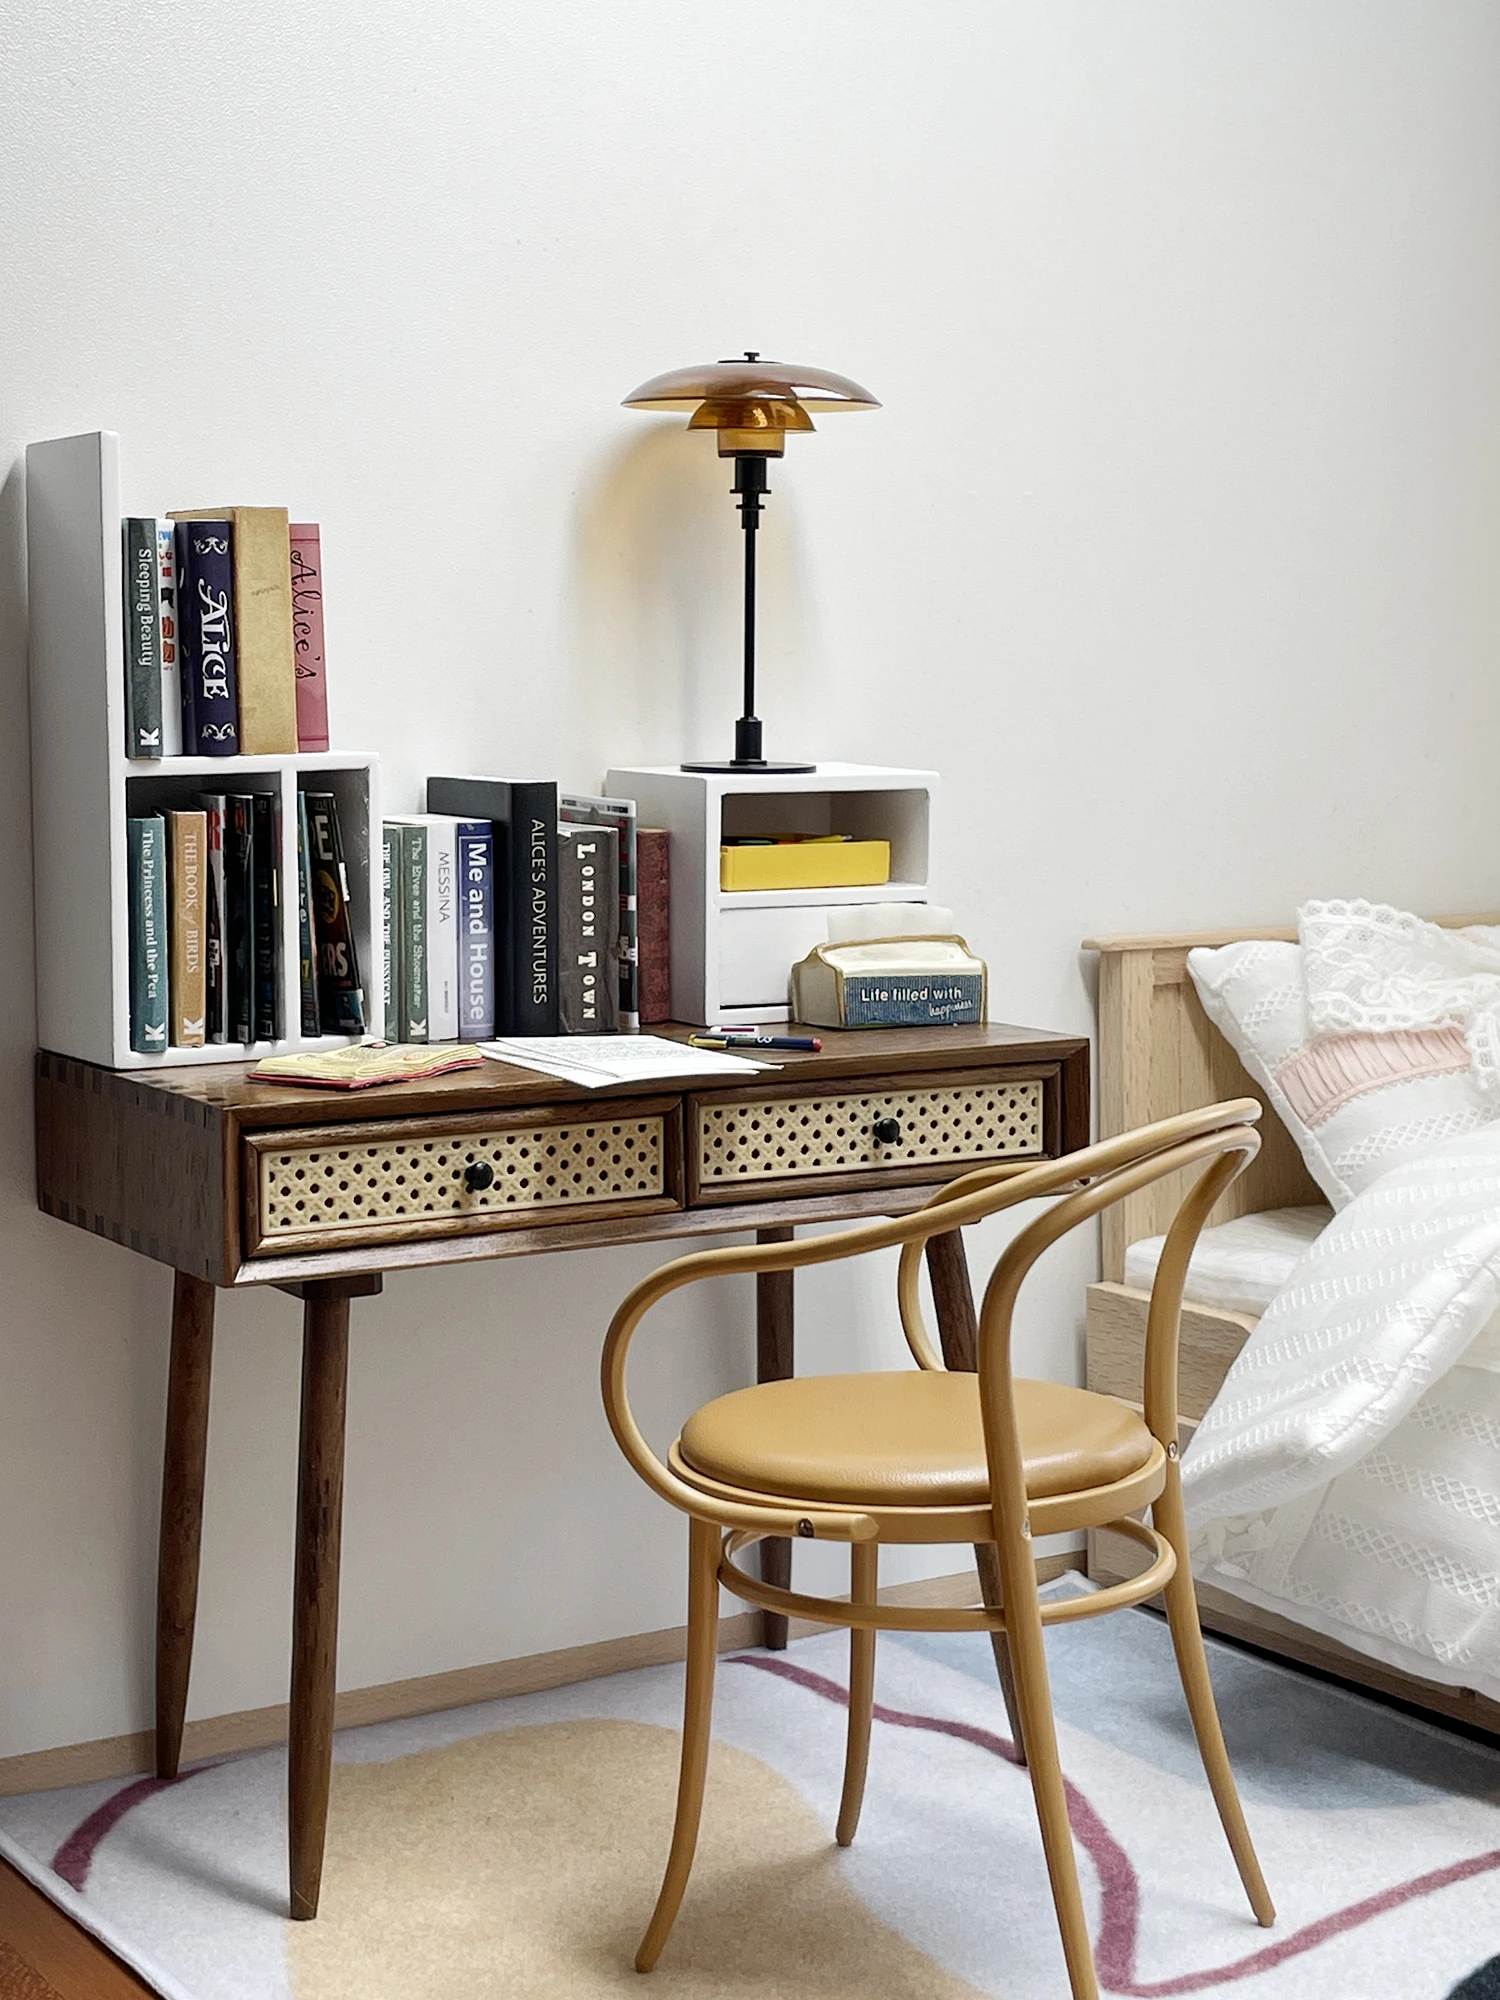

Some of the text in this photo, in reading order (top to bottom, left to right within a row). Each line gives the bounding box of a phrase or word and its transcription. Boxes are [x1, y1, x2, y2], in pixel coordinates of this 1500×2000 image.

[136, 549, 154, 667] Sleeping Beauty
[290, 550, 322, 679] Alice's
[183, 833, 197, 857] THE
[411, 837, 423, 860] The
[142, 830, 159, 999] The Princess and the Pea
[183, 858, 199, 909] BOOK
[412, 899, 423, 921] and
[438, 851, 450, 923] MESSINA
[531, 818, 548, 1005] ALICE'S ADVENTURES
[185, 929, 199, 974] BIRDS
[412, 923, 423, 941] the
[469, 843, 489, 1020] Me and House
[577, 843, 598, 1020] LONDON TOWN
[413, 944, 424, 1009] Shoemaker
[861, 986, 962, 1002] Life filled with
